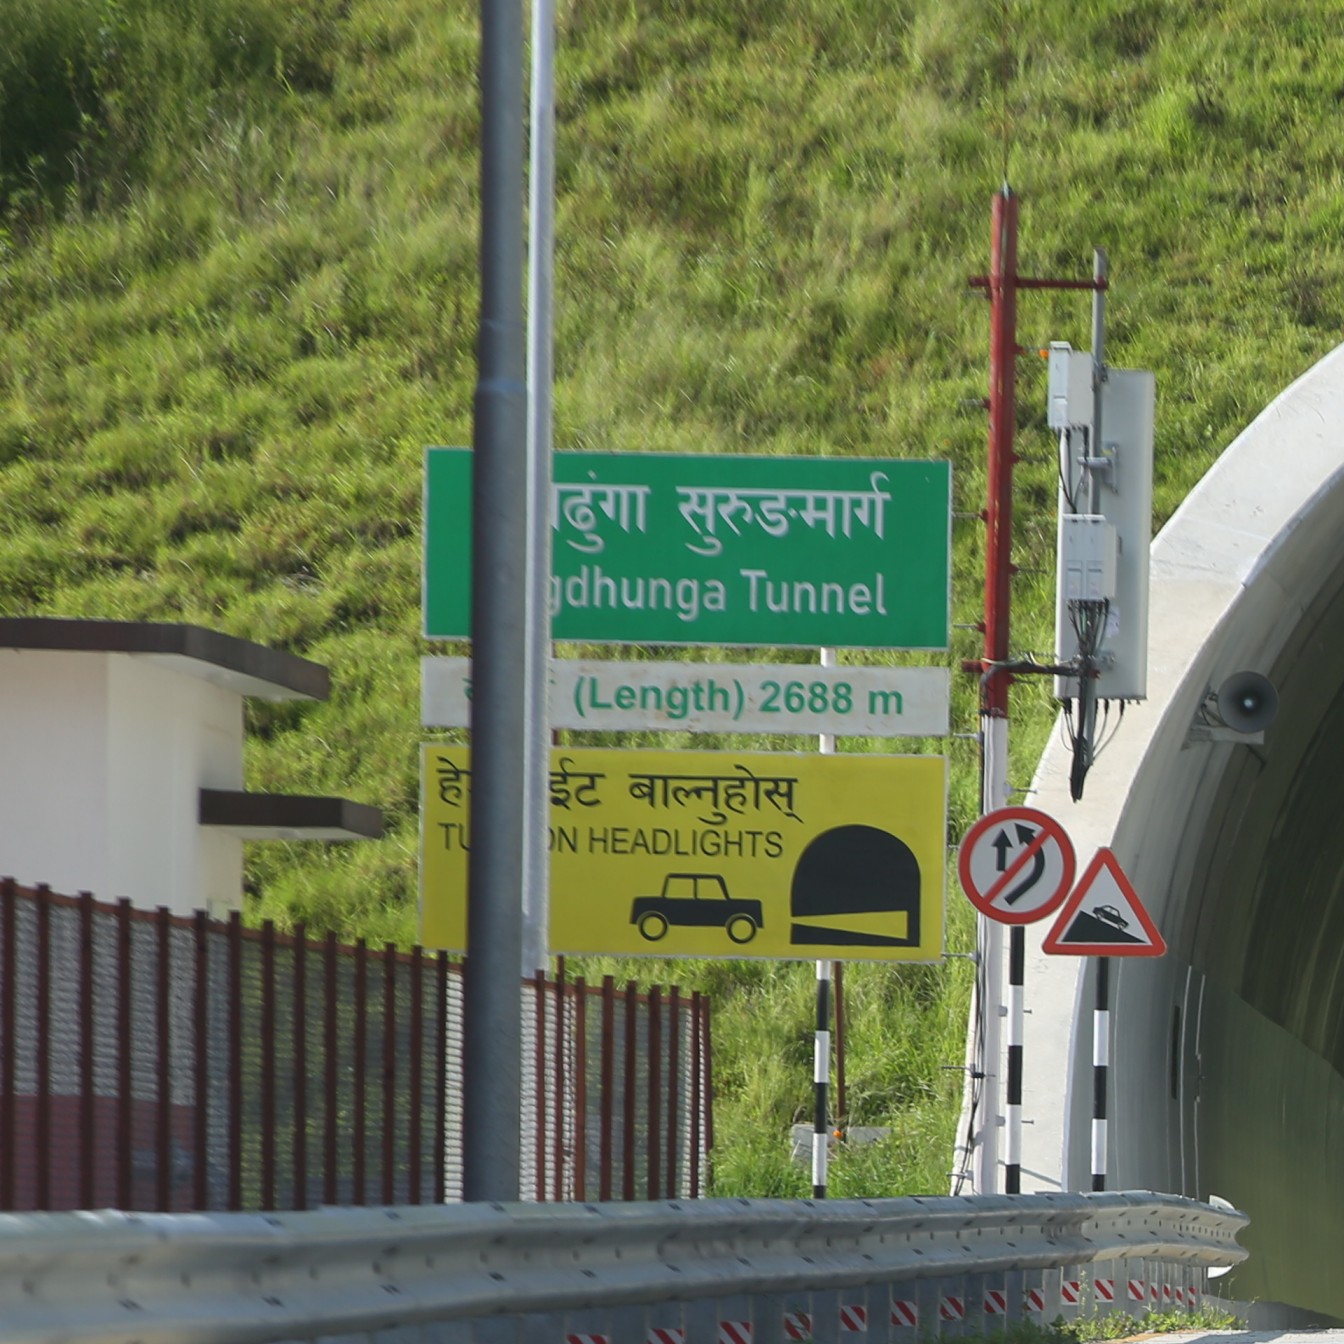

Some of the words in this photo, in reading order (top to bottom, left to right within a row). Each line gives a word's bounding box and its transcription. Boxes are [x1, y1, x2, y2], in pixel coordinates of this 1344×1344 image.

[550, 470, 651, 554] ढुंगा
[549, 565, 725, 622] gdhunga
[740, 569, 887, 615] Tunnel
[574, 678, 745, 719] (Length)
[760, 680, 853, 714] 2688
[869, 688, 904, 715] m
[589, 827, 784, 858] HEADLIGHTS
